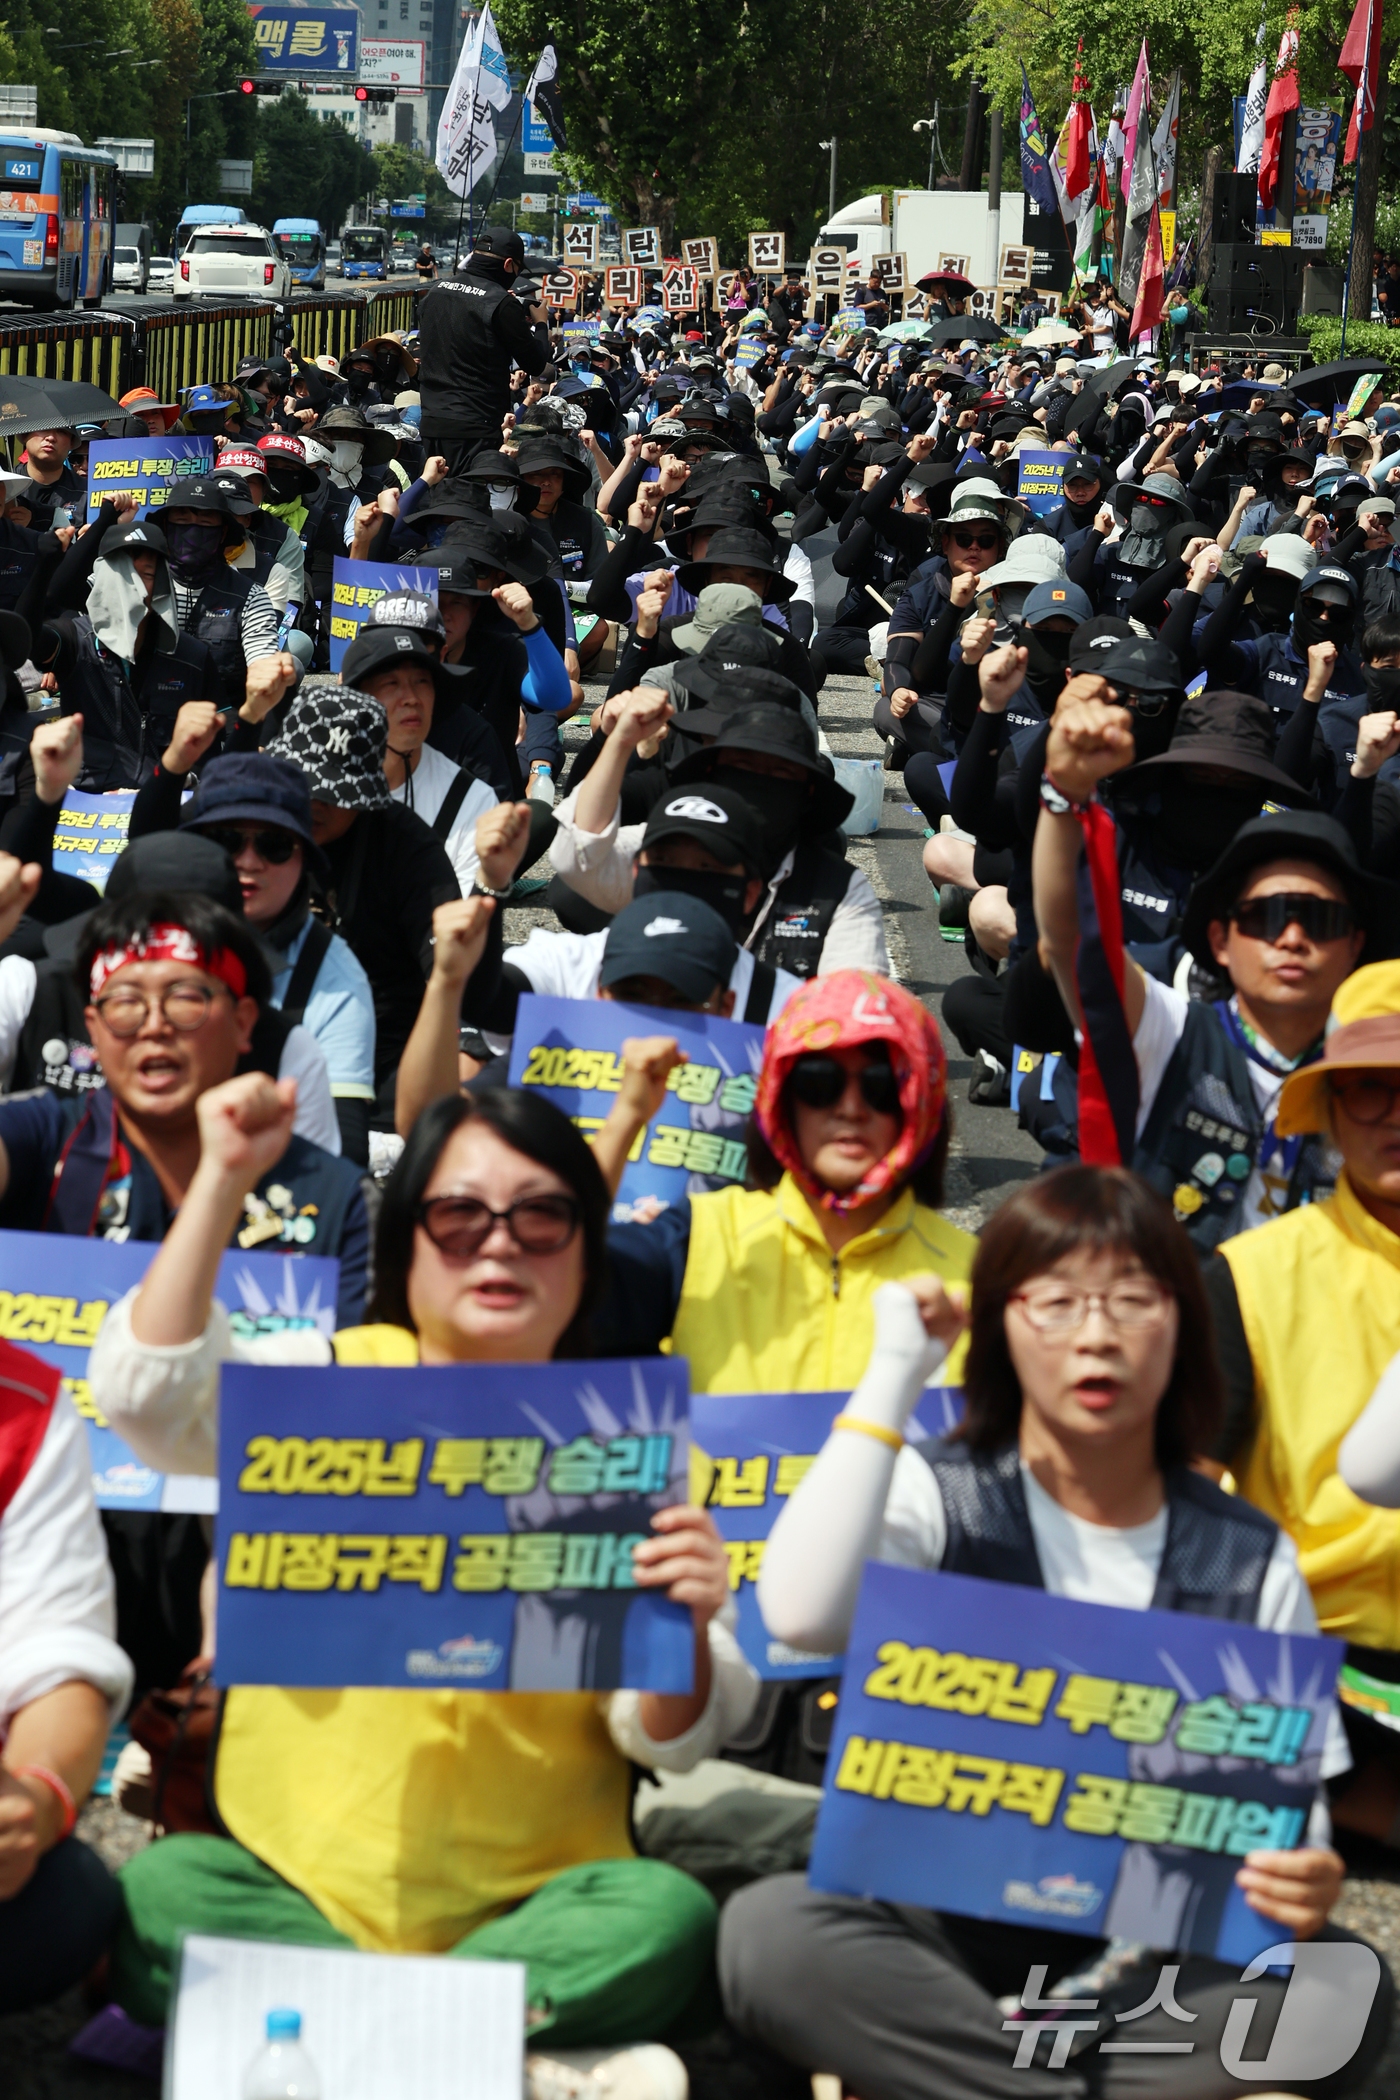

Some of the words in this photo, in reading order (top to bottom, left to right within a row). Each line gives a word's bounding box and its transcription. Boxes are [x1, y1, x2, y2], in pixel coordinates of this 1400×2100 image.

[254, 20, 328, 58] 맥콜
[11, 163, 31, 176] 421
[565, 225, 595, 262] 석
[628, 230, 656, 265] 탄
[686, 240, 713, 274] 발
[753, 235, 780, 268] 전
[814, 252, 841, 287] 은
[877, 255, 903, 289] 멈
[1003, 251, 1028, 280] 도
[546, 270, 574, 304] 우
[611, 269, 636, 303] 리
[666, 269, 693, 305] 삶
[93, 460, 139, 479] 2025년
[141, 459, 173, 476] 투쟁
[1023, 464, 1055, 477] 2025년
[1020, 482, 1058, 496] 비정규직
[375, 597, 428, 622] BREAK
[1268, 671, 1297, 685] 단결투쟁
[239, 1435, 425, 1496] 2025년
[427, 1436, 545, 1496] 투쟁
[225, 1533, 448, 1592] 비정규직
[865, 1641, 1057, 1726] 2025년
[1055, 1673, 1179, 1745] 투쟁
[835, 1734, 1066, 1827] 비정규직
